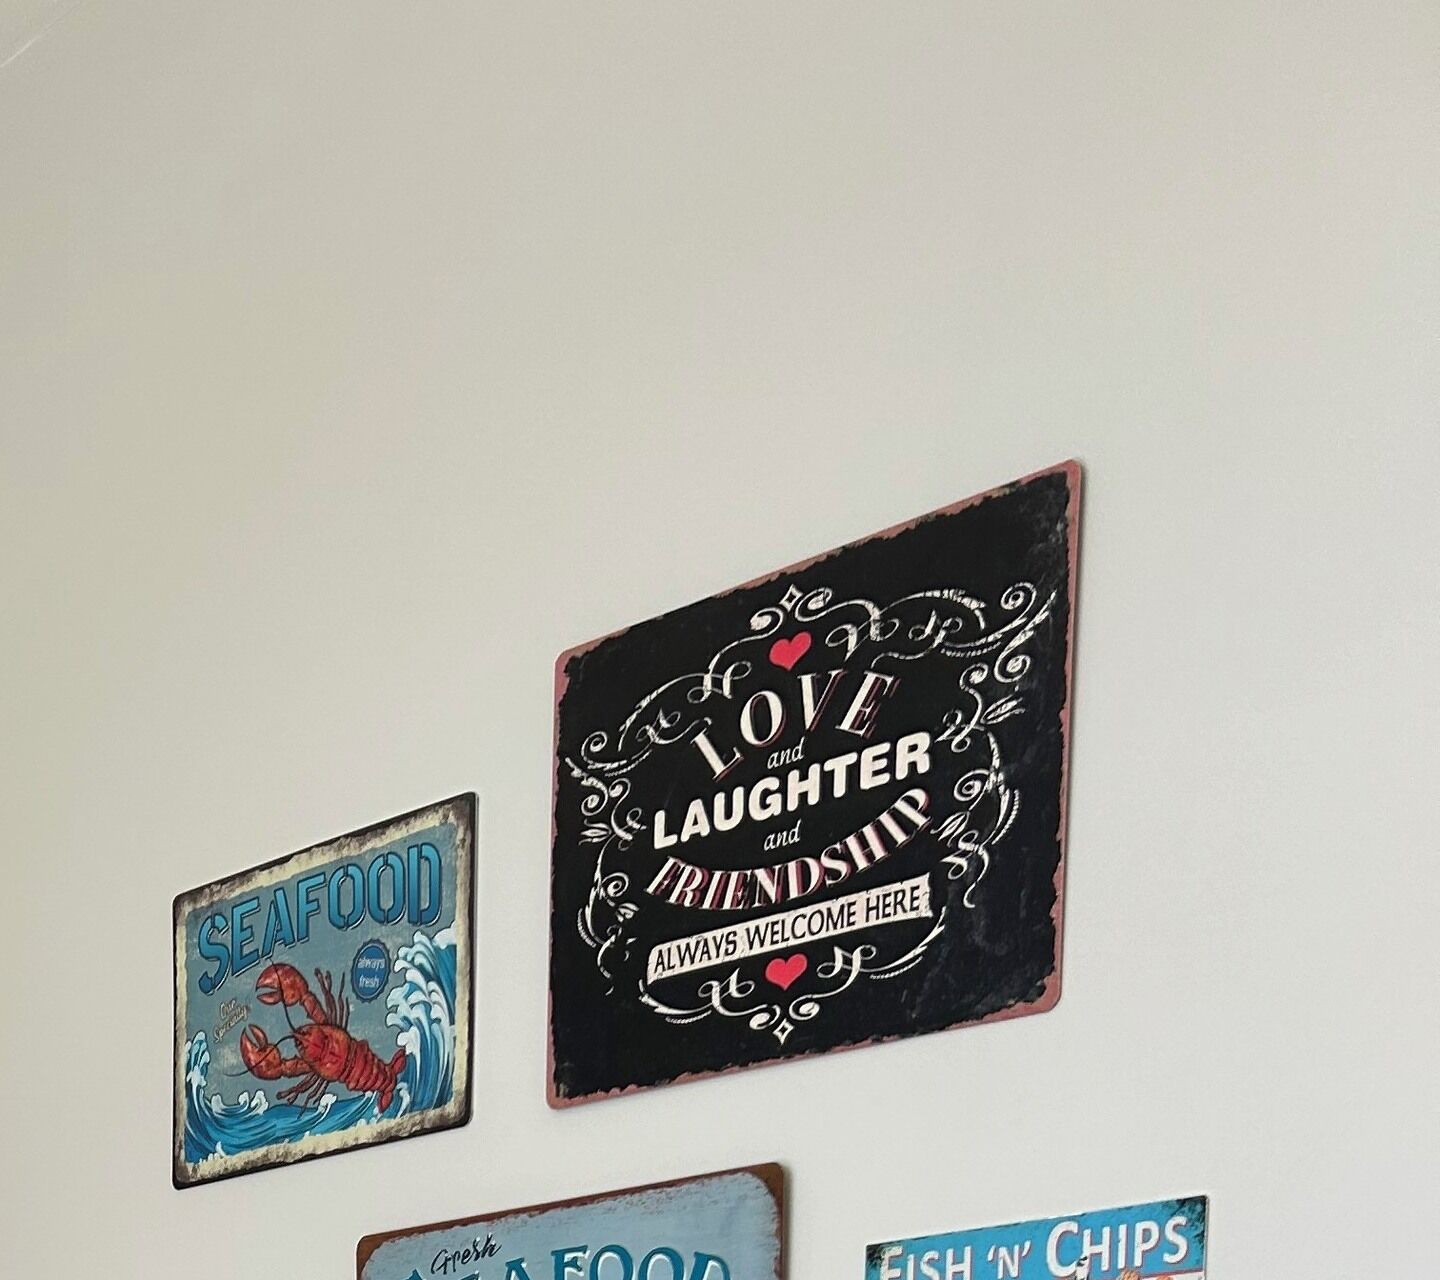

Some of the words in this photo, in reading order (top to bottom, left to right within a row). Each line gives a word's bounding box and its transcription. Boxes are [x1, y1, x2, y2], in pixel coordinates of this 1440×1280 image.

[691, 667, 900, 783] LOVE
[766, 733, 806, 767] and
[653, 730, 933, 852] LAUGHTER
[762, 819, 802, 851] and
[645, 785, 933, 912] FRIENDSHIP
[197, 841, 445, 996] SEAFOOD
[654, 931, 737, 974] ALWAYS
[746, 901, 857, 950] WELCOME
[865, 885, 921, 922] HERE
[1045, 1215, 1190, 1279] CHIPS
